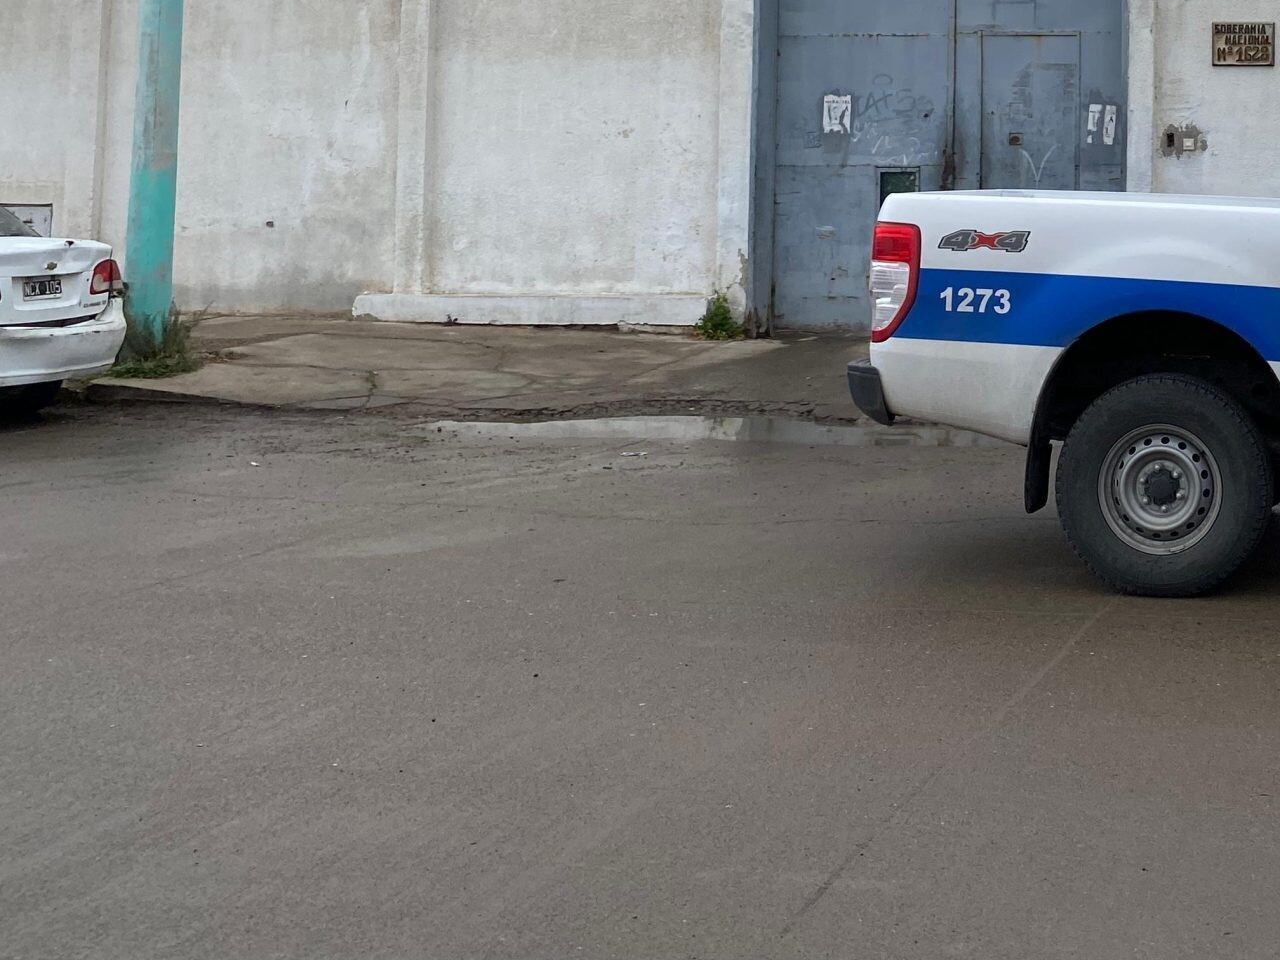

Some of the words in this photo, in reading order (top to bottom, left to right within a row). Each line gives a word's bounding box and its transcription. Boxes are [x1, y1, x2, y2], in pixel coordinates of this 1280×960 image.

[1214, 24, 1266, 35] SOBERANIA
[1225, 35, 1271, 46] NACIONAL
[24, 281, 40, 296] NCX
[940, 286, 1011, 315] 1273
